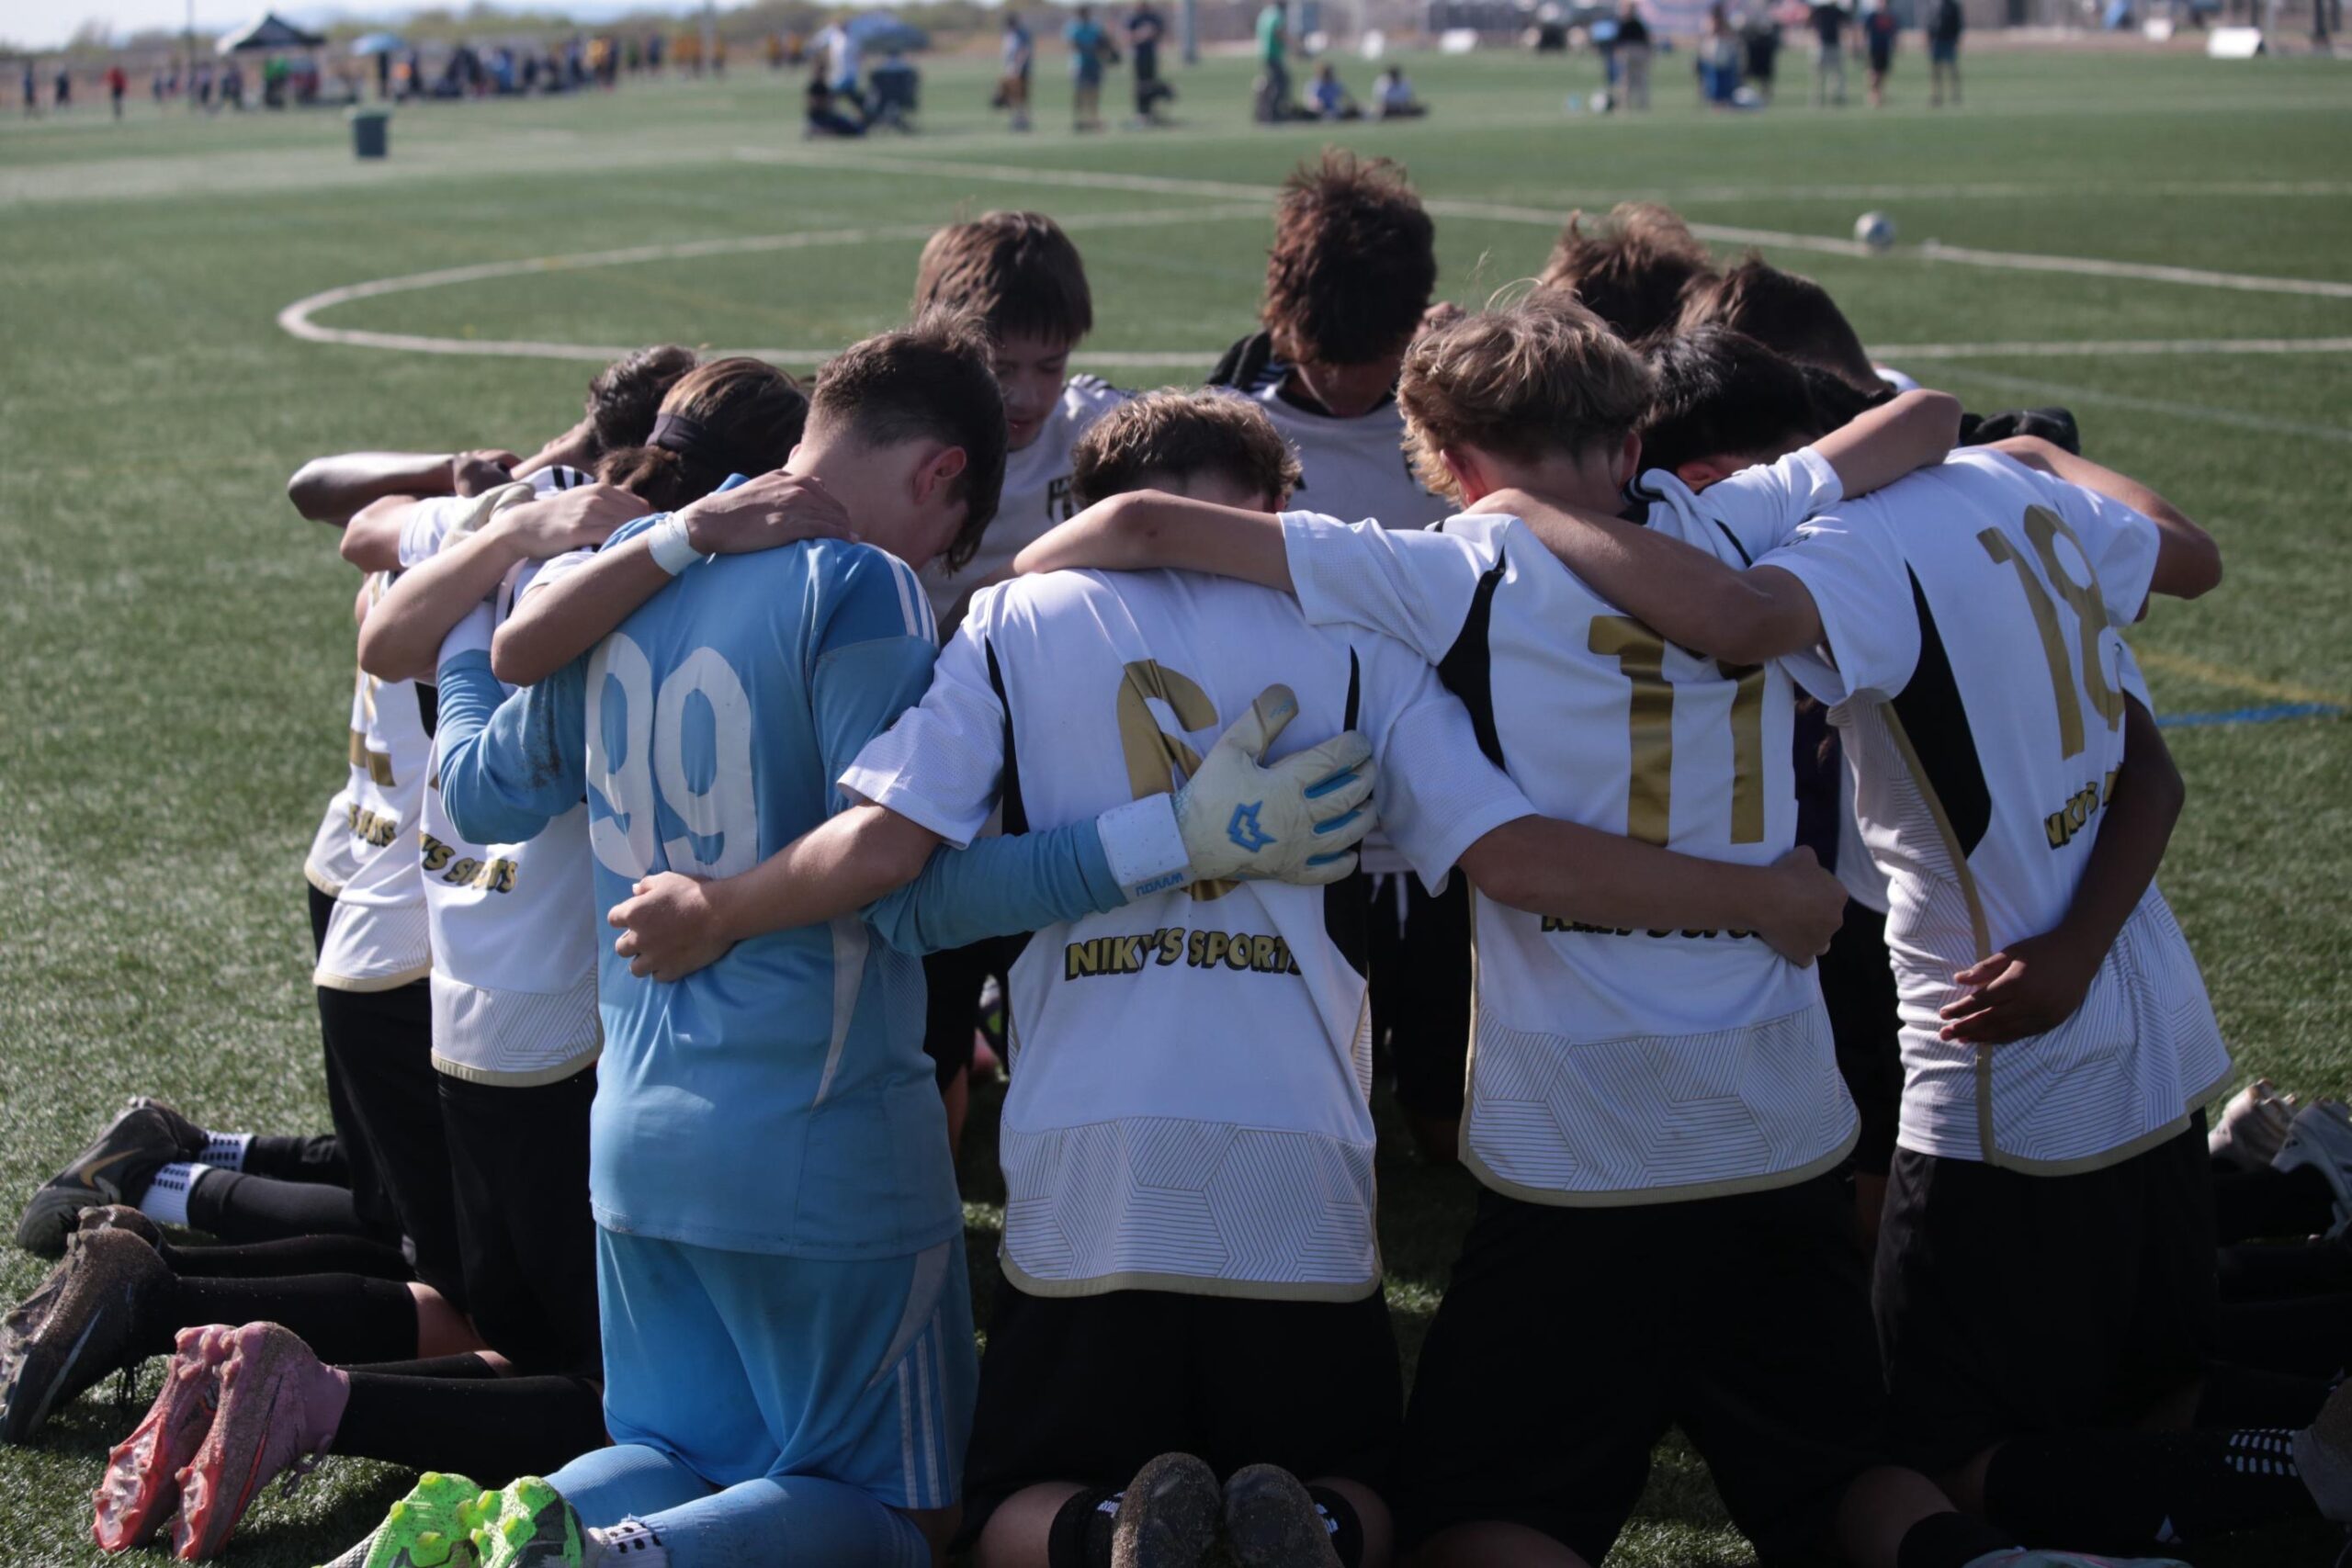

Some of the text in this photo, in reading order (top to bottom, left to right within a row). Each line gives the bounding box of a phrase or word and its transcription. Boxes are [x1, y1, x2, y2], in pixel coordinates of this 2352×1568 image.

[1588, 615, 1765, 847] 11
[1976, 504, 2125, 761] 18
[585, 632, 757, 881] 99
[1065, 927, 1185, 981] NIKY'S
